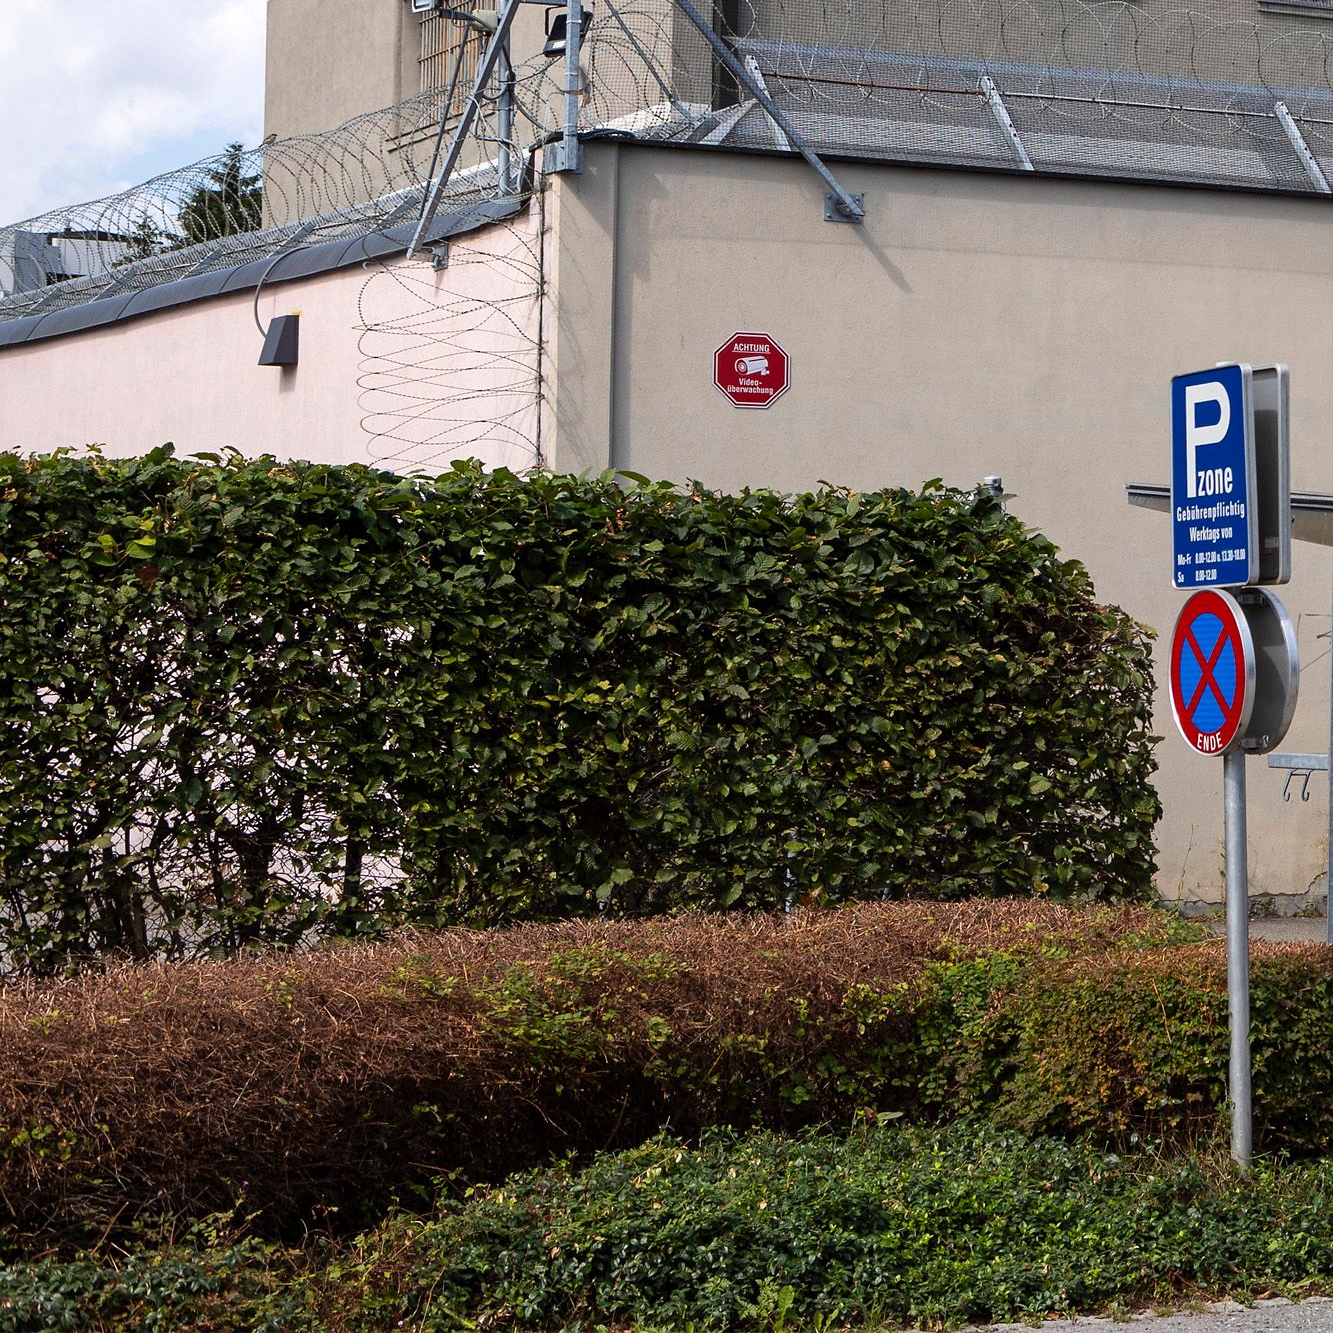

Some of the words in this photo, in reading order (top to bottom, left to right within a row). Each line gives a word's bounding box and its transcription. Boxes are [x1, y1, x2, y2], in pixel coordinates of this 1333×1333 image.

[733, 343, 770, 352] ACHTUNG
[738, 378, 762, 386] Video-
[1197, 466, 1233, 497] zone
[1176, 500, 1245, 522] Gebührenpflichtig
[1189, 526, 1220, 543] Werktags
[1220, 527, 1233, 539] von
[1177, 553, 1192, 566] Mo-Fr
[1177, 571, 1185, 583] Sa
[1196, 731, 1223, 752] ENDE
